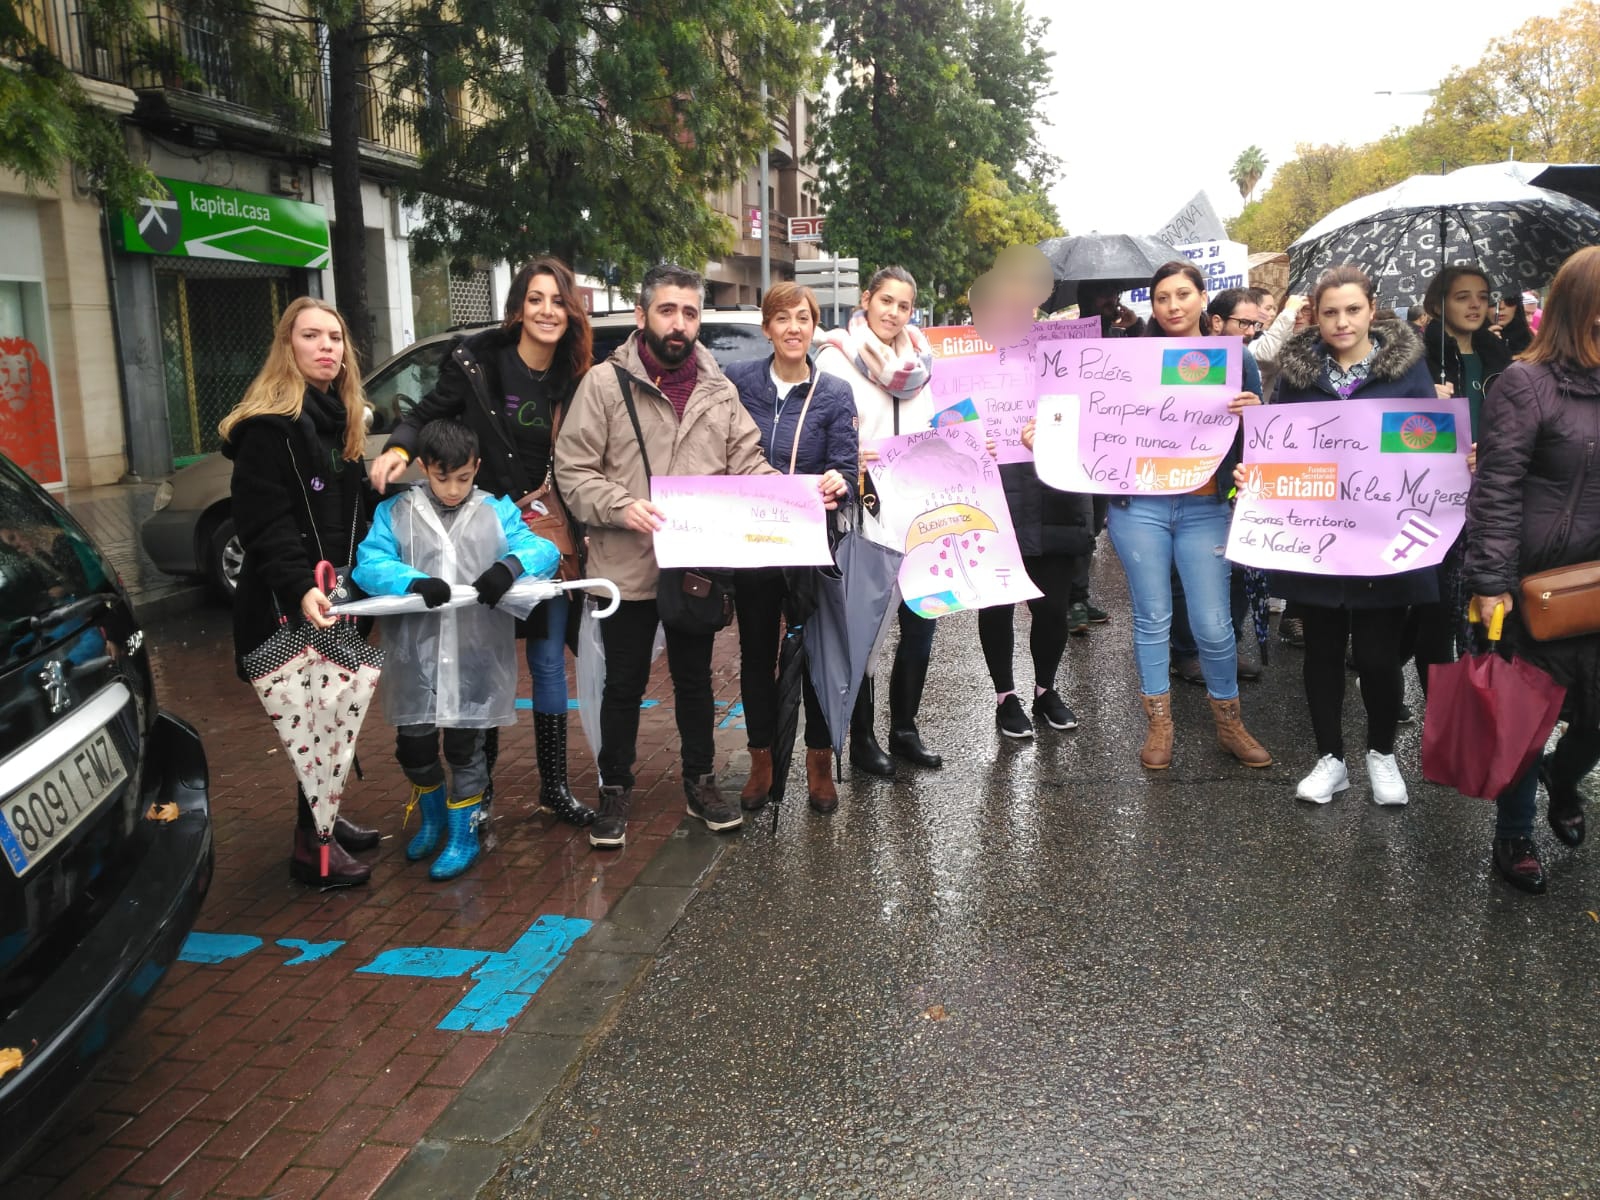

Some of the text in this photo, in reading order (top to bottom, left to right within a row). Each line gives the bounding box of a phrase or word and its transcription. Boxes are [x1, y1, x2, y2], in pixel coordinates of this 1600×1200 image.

[190, 191, 271, 222] kapital.casa
[1040, 349, 1068, 378] Me
[1078, 347, 1133, 383] Podéis
[1089, 391, 1156, 425] Romper
[1184, 409, 1234, 427] mano
[886, 447, 902, 462] EL
[907, 429, 940, 447] AMOR
[946, 428, 960, 439] NO
[986, 427, 1019, 438] ES UN
[1093, 431, 1127, 452] pero
[1135, 435, 1182, 450] nunca
[1249, 414, 1281, 450] Ni
[1308, 415, 1369, 450] Tierra
[1277, 475, 1335, 497] Gitano
[1340, 470, 1363, 502] Ni
[1397, 467, 1468, 520] Mujeres
[917, 517, 948, 534] BUENOS
[1286, 508, 1357, 528] territorio
[1239, 529, 1257, 546] de
[12, 735, 121, 851] 8091 FMZ
[11, 848, 21, 862] E
